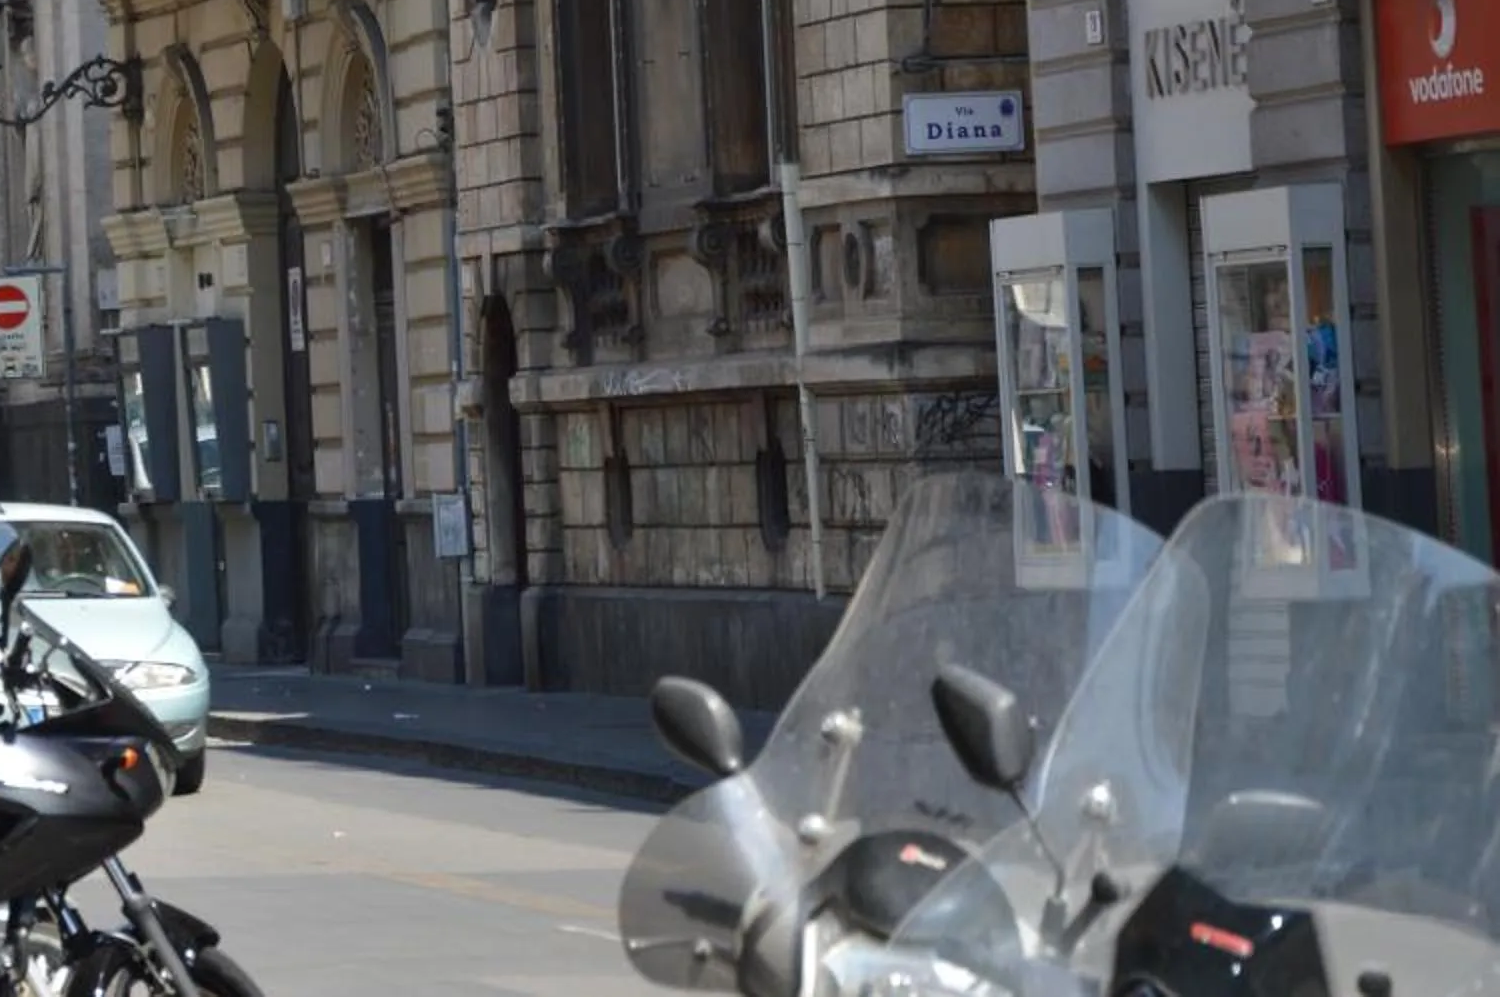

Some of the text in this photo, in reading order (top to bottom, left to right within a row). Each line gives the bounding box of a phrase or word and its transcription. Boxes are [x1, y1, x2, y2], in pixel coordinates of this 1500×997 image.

[1408, 61, 1484, 105] vodafone
[955, 105, 975, 117] Via
[927, 122, 1003, 140] Diana
